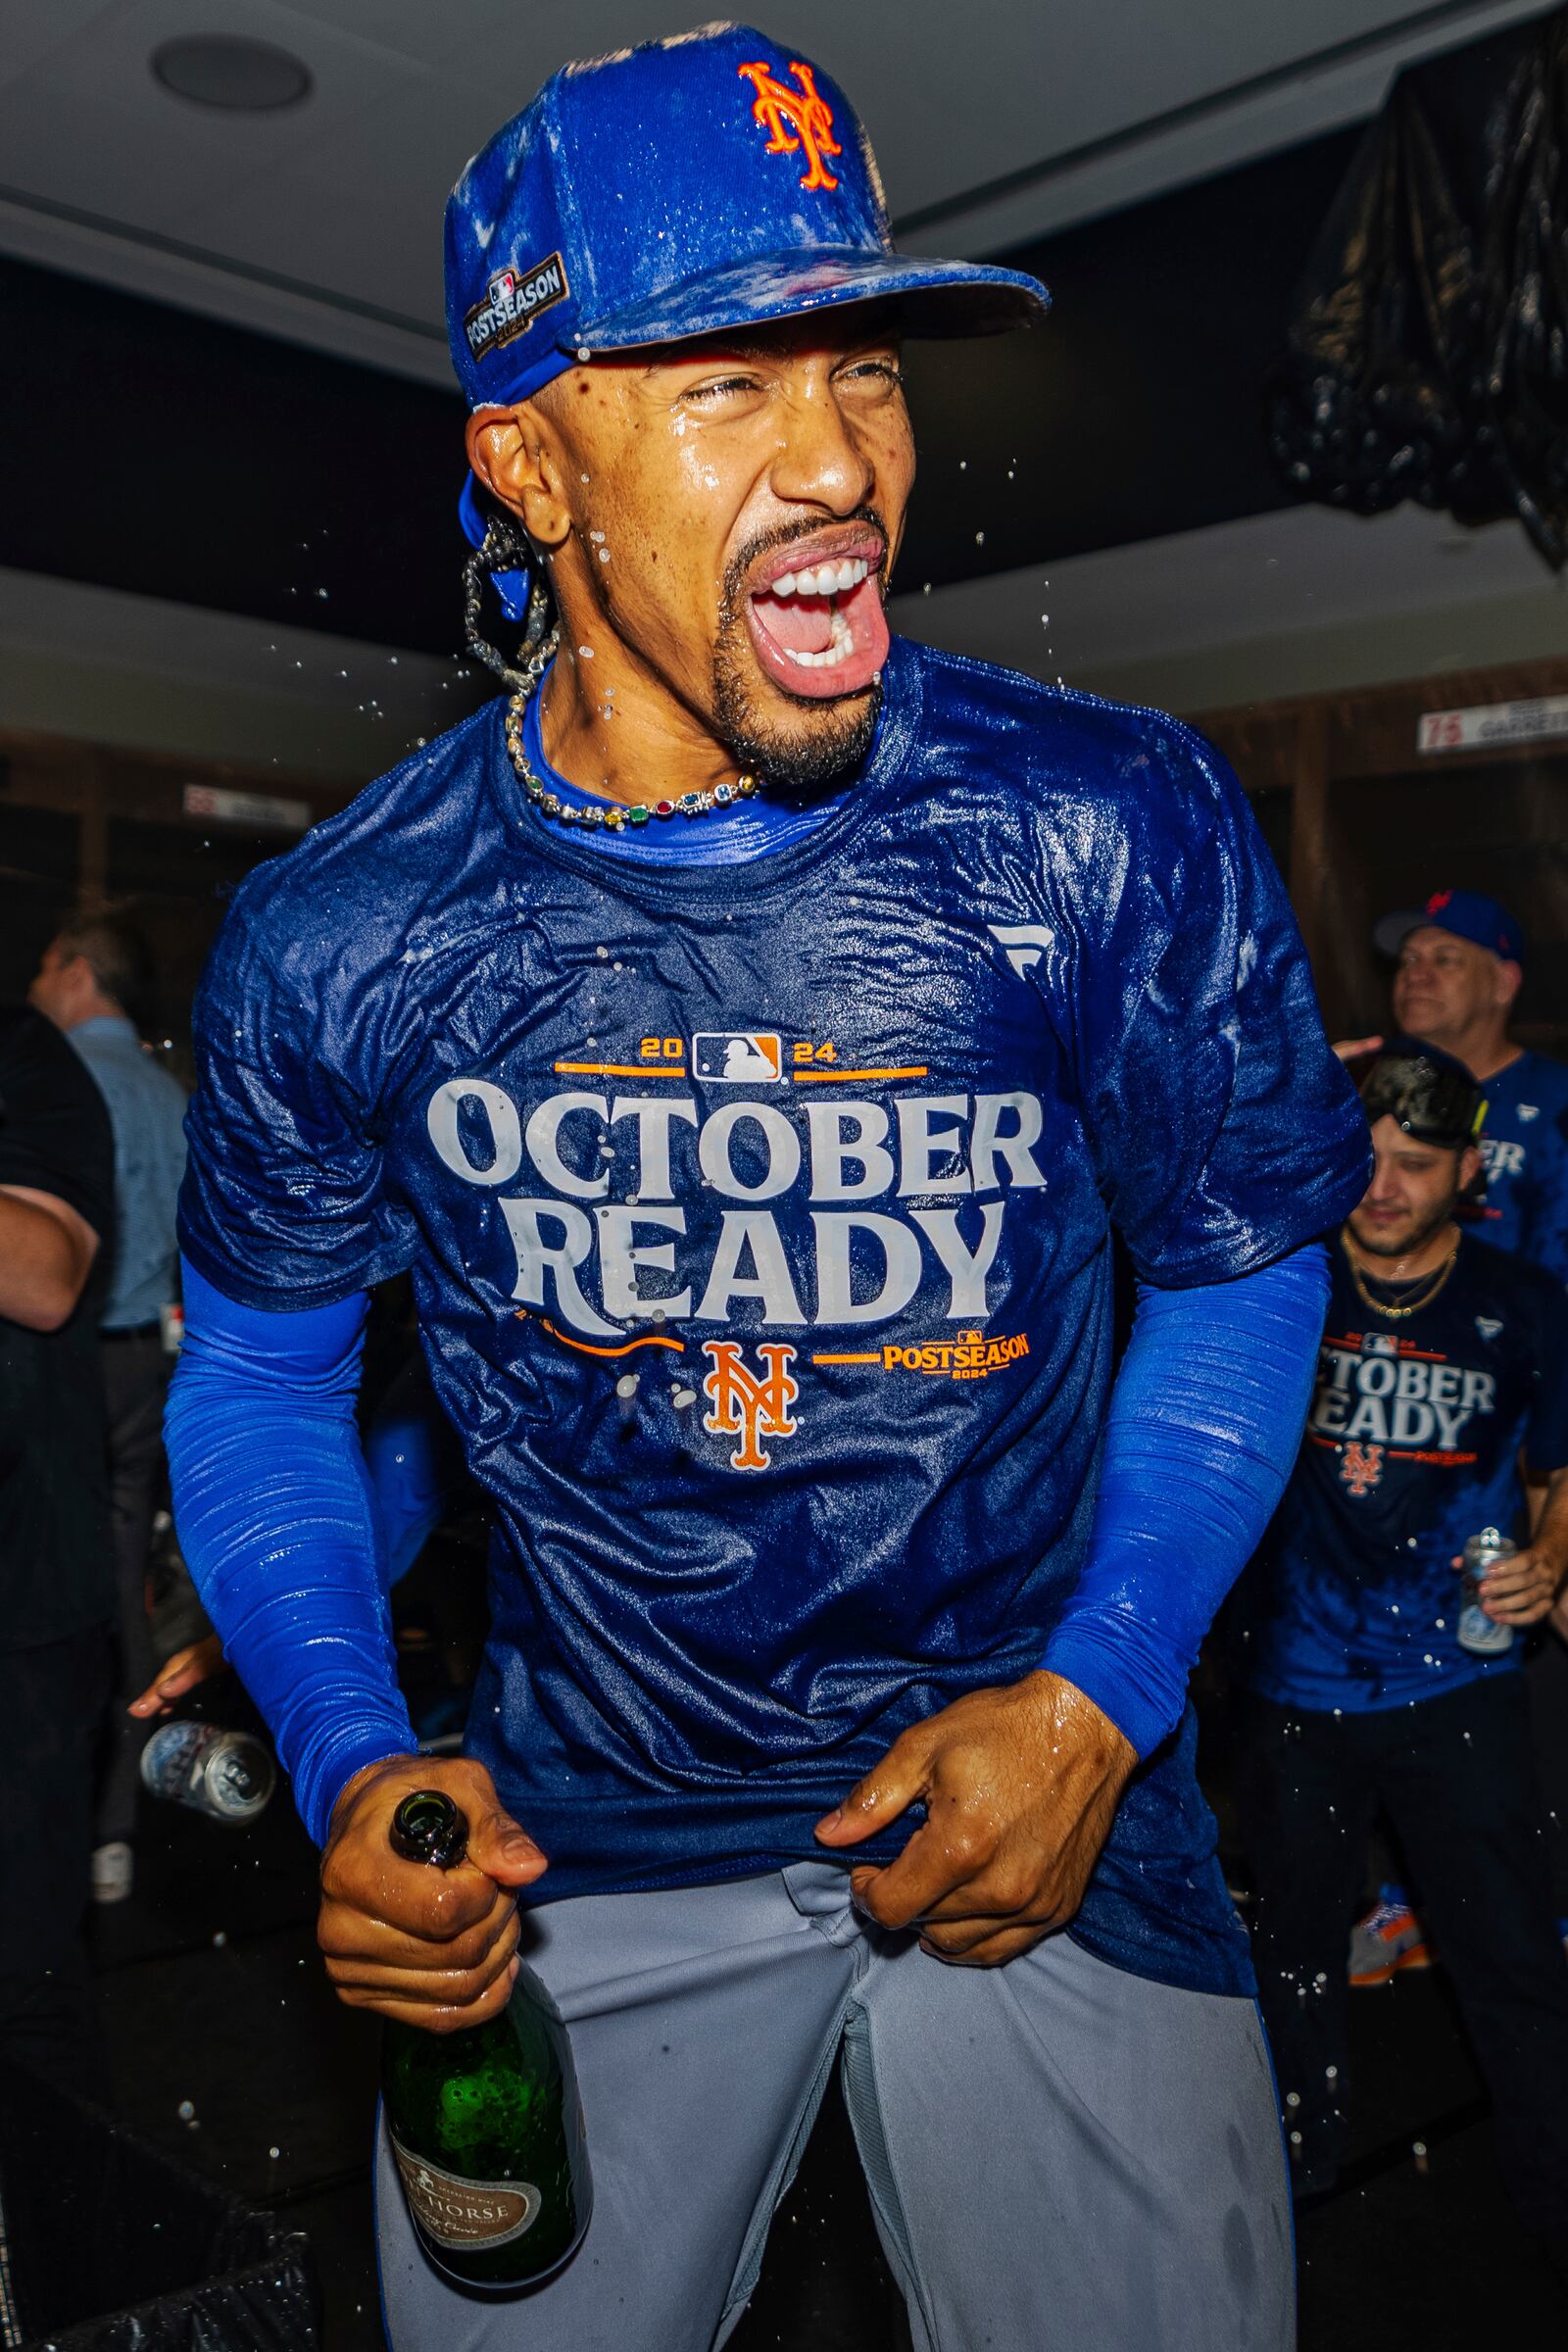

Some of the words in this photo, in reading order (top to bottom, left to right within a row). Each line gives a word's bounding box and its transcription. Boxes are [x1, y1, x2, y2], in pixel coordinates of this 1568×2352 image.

[738, 61, 842, 191] NY
[466, 266, 561, 350] POSTSEASON
[641, 1038, 683, 1058] 20
[793, 1042, 837, 1063] 24
[427, 1078, 1047, 1201] OCTOBER
[498, 1197, 1005, 1337] READY
[883, 1333, 1030, 1370] POSTSEASON
[952, 1369, 989, 1380] 2024
[1321, 1347, 1495, 1412] TOBER
[702, 1340, 799, 1471] NY
[1314, 1388, 1473, 1450] EADY
[428, 2195, 509, 2220] HORSE
